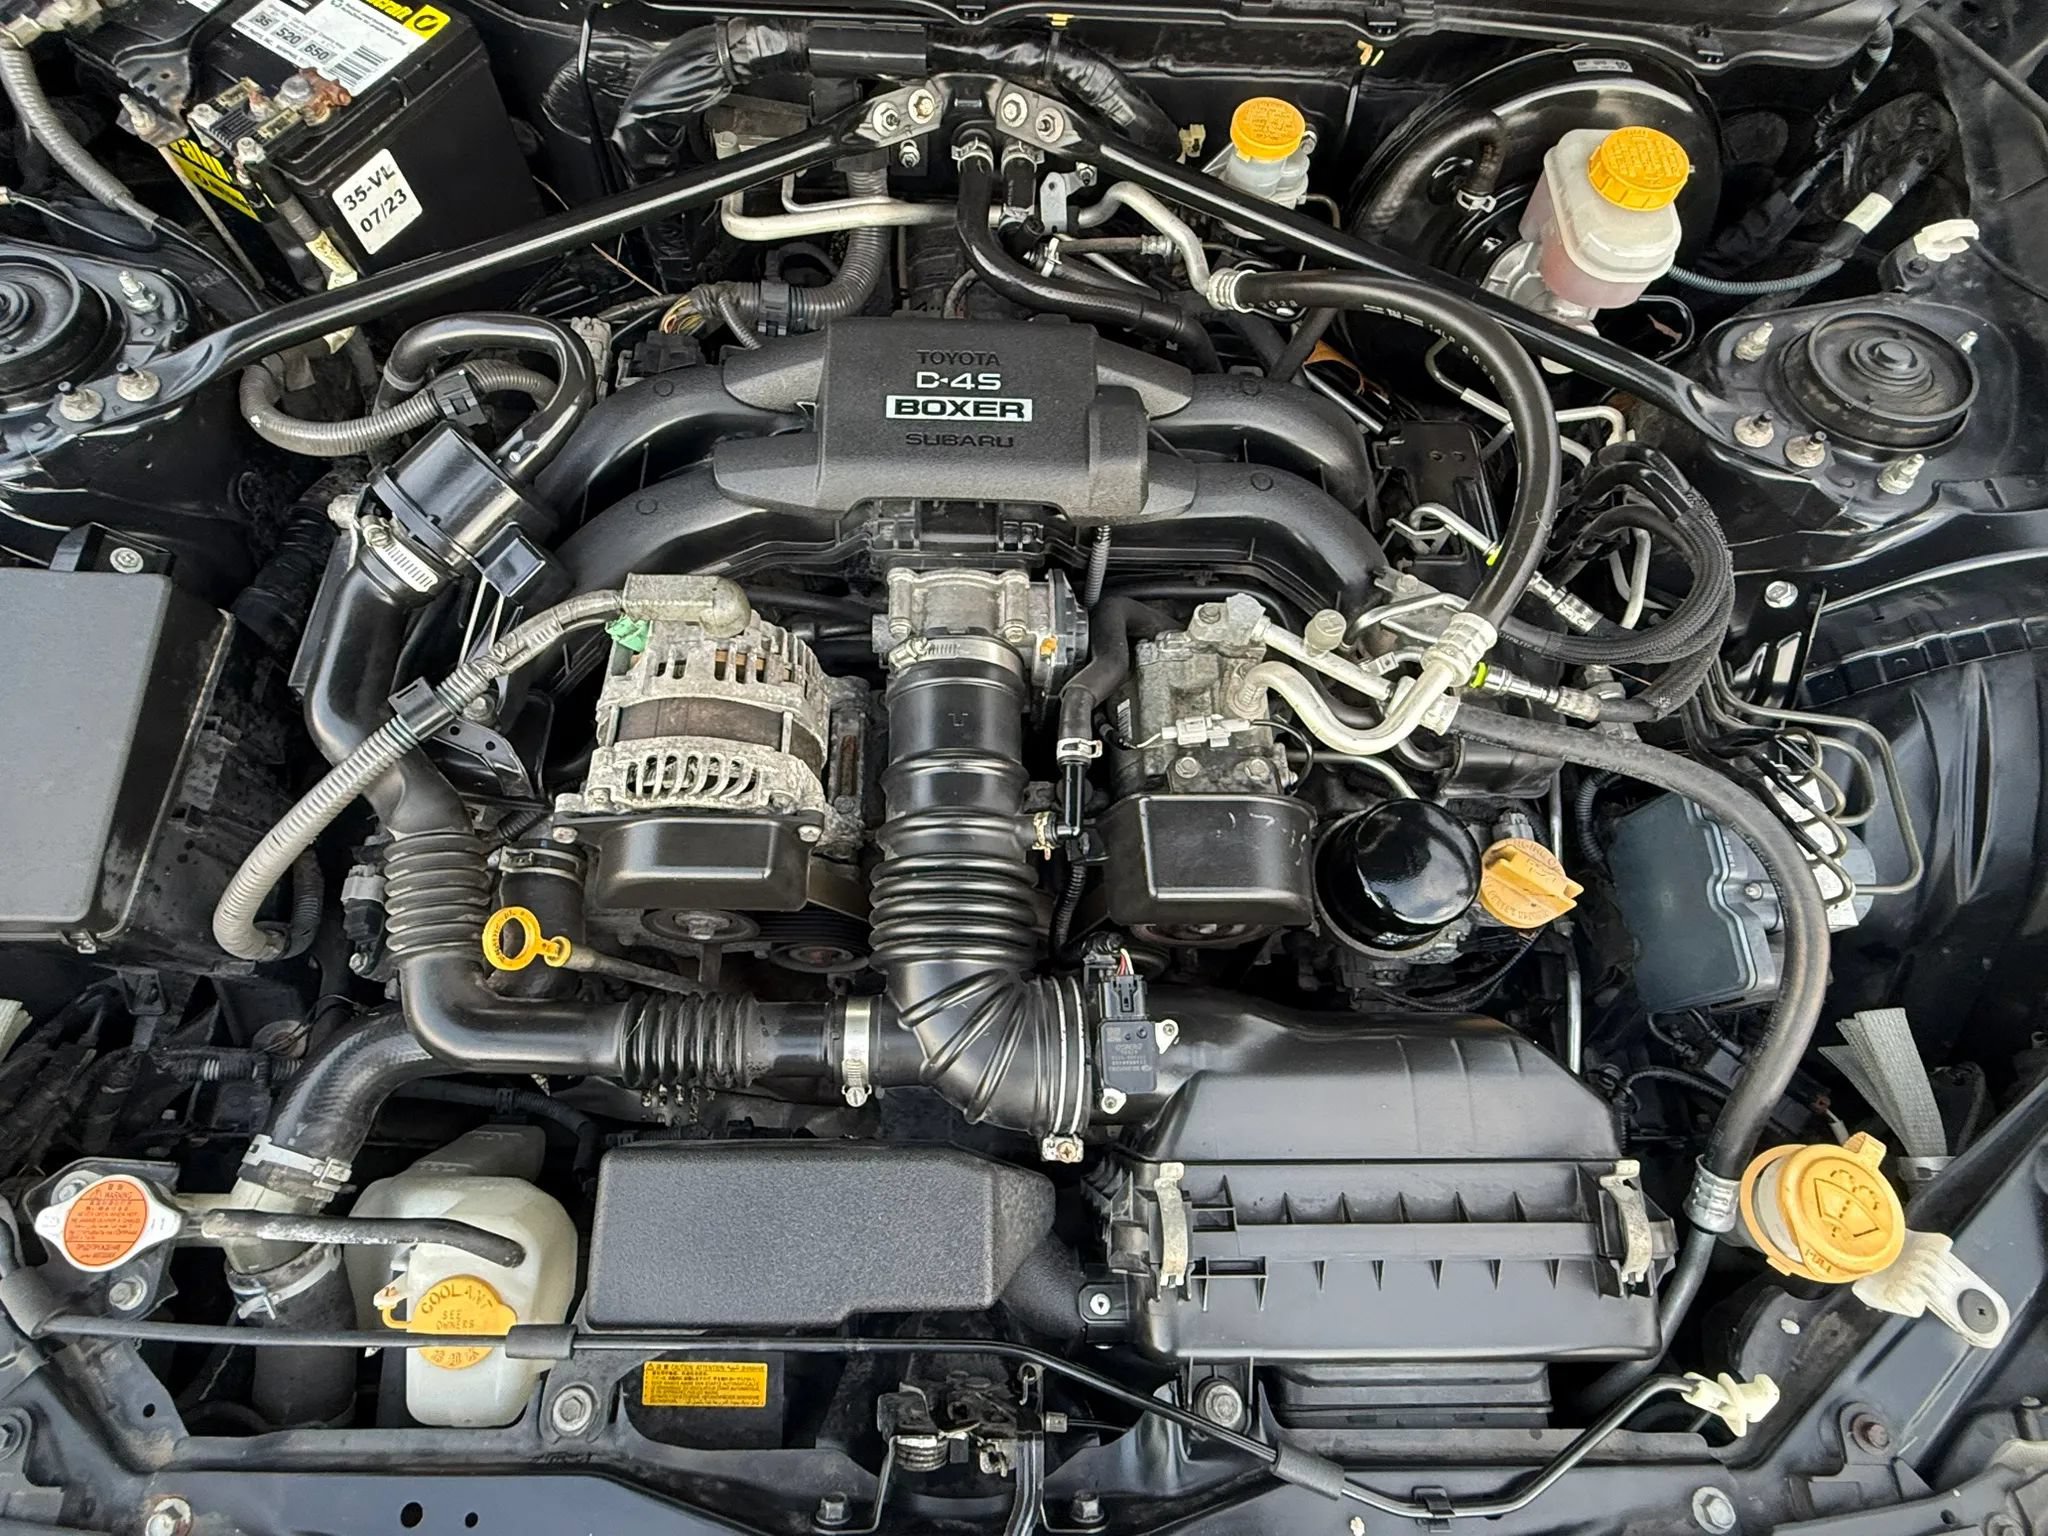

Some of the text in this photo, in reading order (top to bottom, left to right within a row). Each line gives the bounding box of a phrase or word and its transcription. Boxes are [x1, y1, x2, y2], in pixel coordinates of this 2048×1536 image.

[255, 15, 273, 27] 35
[276, 27, 302, 45] 520
[304, 43, 329, 61] 650
[343, 166, 396, 211] 35-VL
[360, 188, 407, 233] 07/23
[917, 351, 1000, 366] TOYOTA
[894, 398, 1025, 418] BOXER
[906, 432, 1014, 448] SUBARU
[421, 1283, 493, 1314] COOLANT
[442, 1309, 462, 1320] SEE
